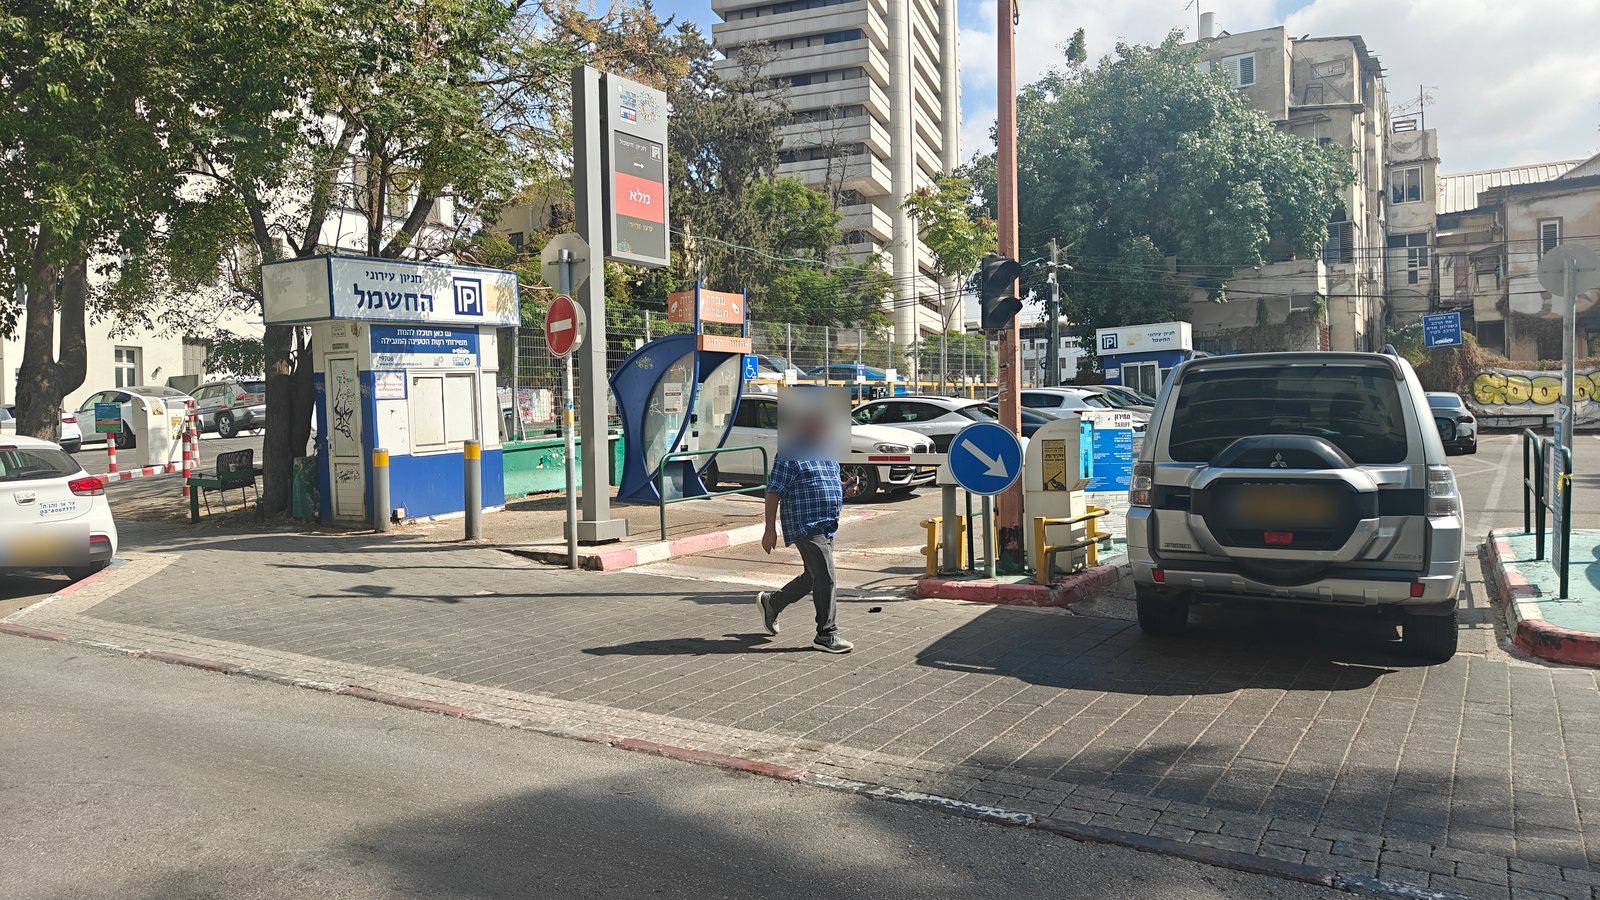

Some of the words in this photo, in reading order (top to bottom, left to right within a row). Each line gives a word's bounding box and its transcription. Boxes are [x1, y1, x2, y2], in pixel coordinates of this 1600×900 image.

[629, 188, 651, 205] מלא
[365, 270, 395, 282] עירוני
[400, 273, 422, 285] חניון
[353, 283, 434, 312] החשמל
[397, 328, 415, 336] להנות
[434, 330, 444, 338] כאן
[380, 337, 407, 345] המובילה
[408, 338, 430, 346] הטעינה
[431, 338, 445, 346] רשת
[1114, 413, 1131, 421] מחירון
